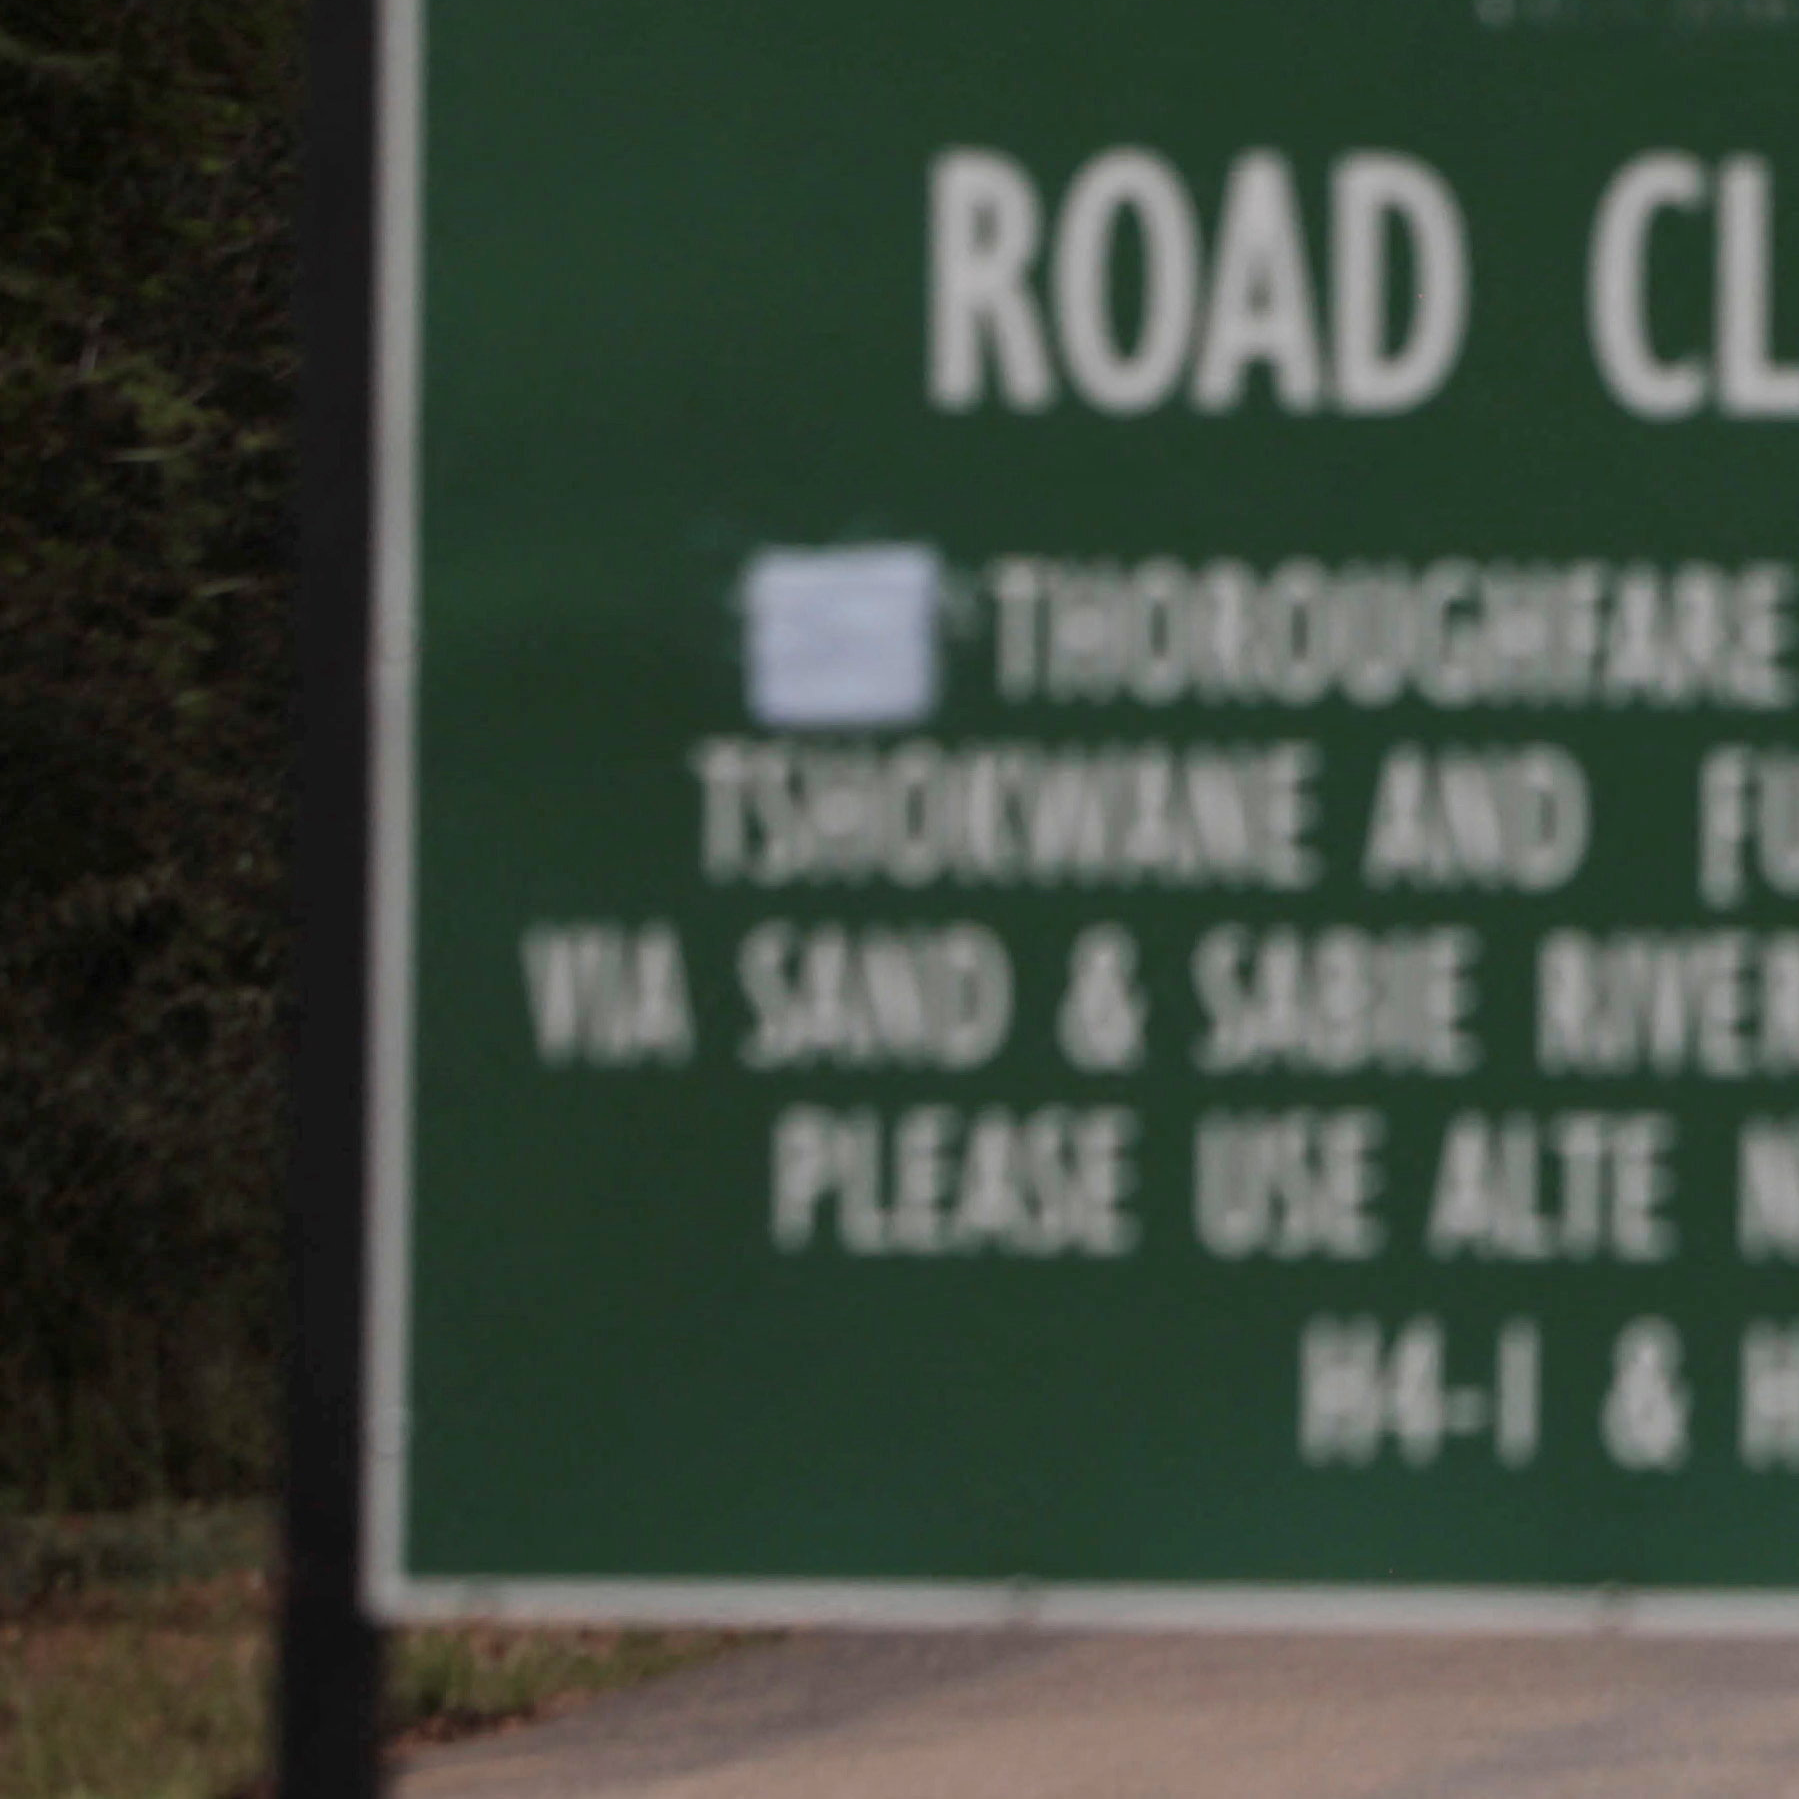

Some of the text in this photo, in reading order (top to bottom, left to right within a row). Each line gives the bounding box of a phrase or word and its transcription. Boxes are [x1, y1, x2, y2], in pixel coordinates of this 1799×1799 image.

[925, 146, 1470, 417] ROAD
[990, 554, 1797, 707] THOROUGHFARE
[694, 737, 1320, 889] TSHOKWANE
[1364, 745, 1592, 891] AND
[520, 920, 695, 1068] VIA
[738, 919, 1016, 1071] SAND
[1057, 923, 1150, 1073] &
[1192, 925, 1484, 1075] SABIE
[771, 1103, 1142, 1257] PLEASE
[1190, 1108, 1388, 1259] USE
[1599, 1320, 1690, 1469] &
